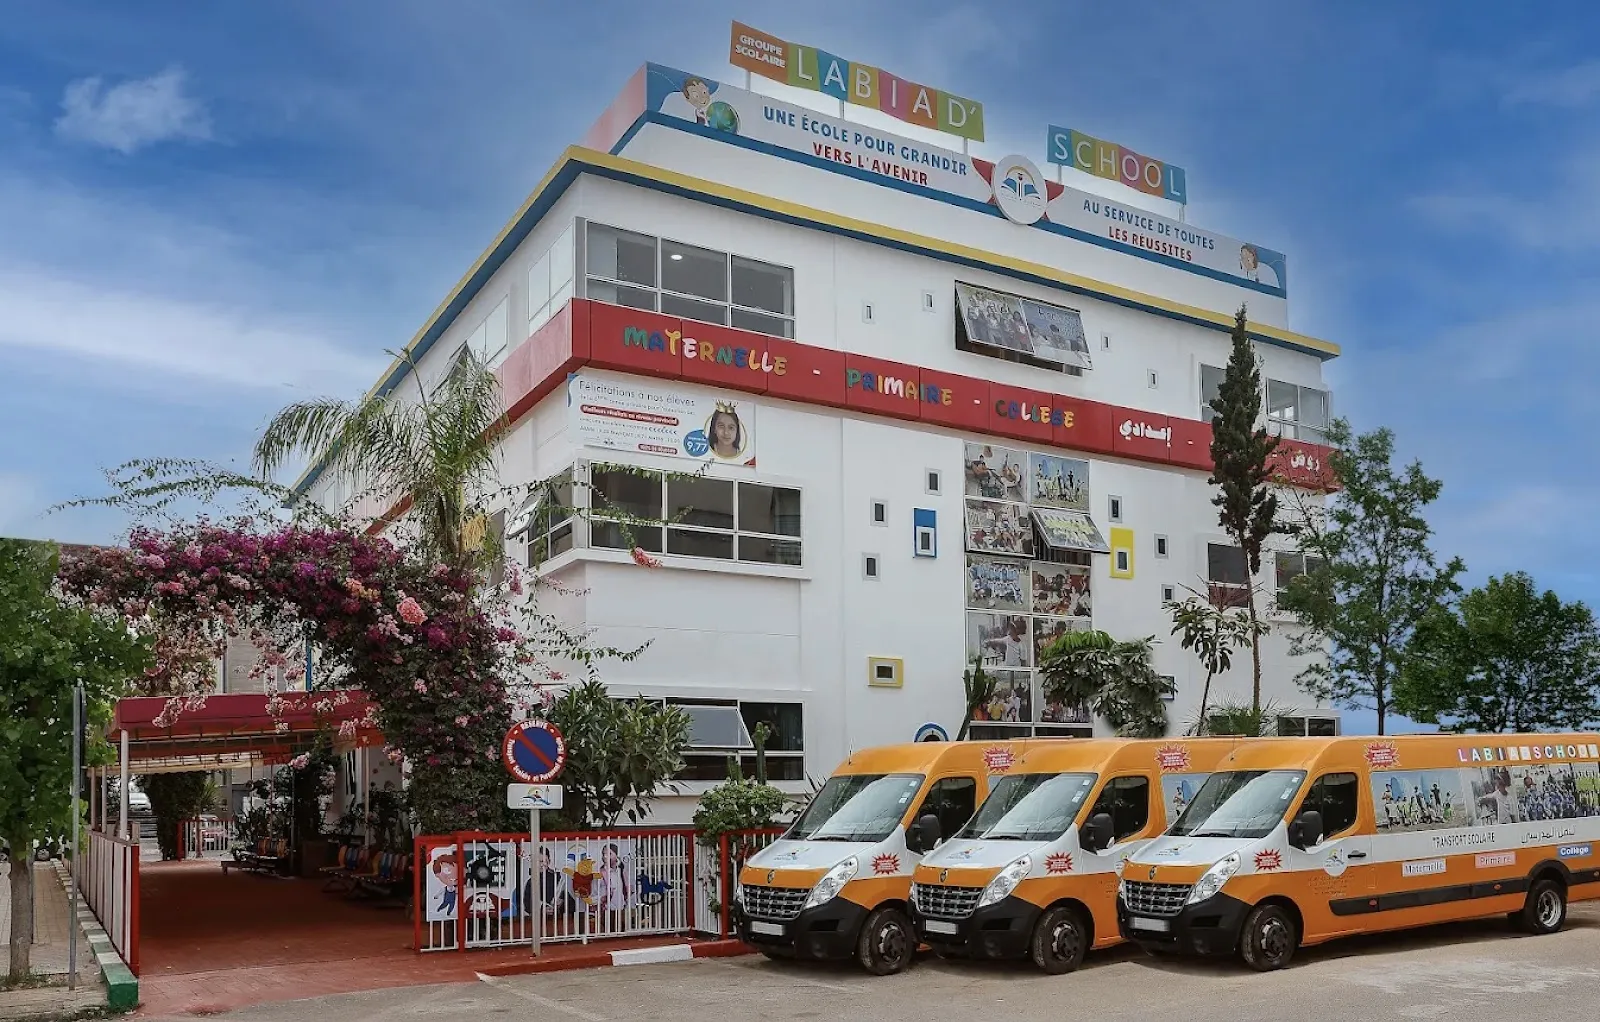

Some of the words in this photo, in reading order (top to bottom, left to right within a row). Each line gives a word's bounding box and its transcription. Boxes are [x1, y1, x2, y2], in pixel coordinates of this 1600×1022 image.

[735, 44, 786, 68] SCOLAIRE
[740, 35, 782, 56] GROUPE
[797, 48, 976, 128] LABIAD'
[1054, 132, 1181, 196] SCHOOL
[763, 106, 796, 128] UNE
[802, 114, 848, 143] ÉCOLE
[854, 132, 896, 156] POUR
[901, 146, 967, 176] GRANDIR
[812, 141, 852, 164] VERS
[858, 154, 929, 186] L'AVENIR
[1083, 199, 1100, 214] AU
[1104, 205, 1153, 231] SERVICE
[1157, 222, 1171, 236] DE
[1174, 227, 1215, 250] TOUTES
[1108, 226, 1128, 242] LES
[1132, 232, 1192, 261] RÉUSSITES
[624, 327, 788, 375] MATERNELLE
[846, 368, 953, 406] PRIMAIRE
[995, 399, 1074, 428] COLLEGE
[647, 393, 663, 403] nos
[687, 441, 707, 452] 9,77
[1119, 419, 1172, 448] إعدادي
